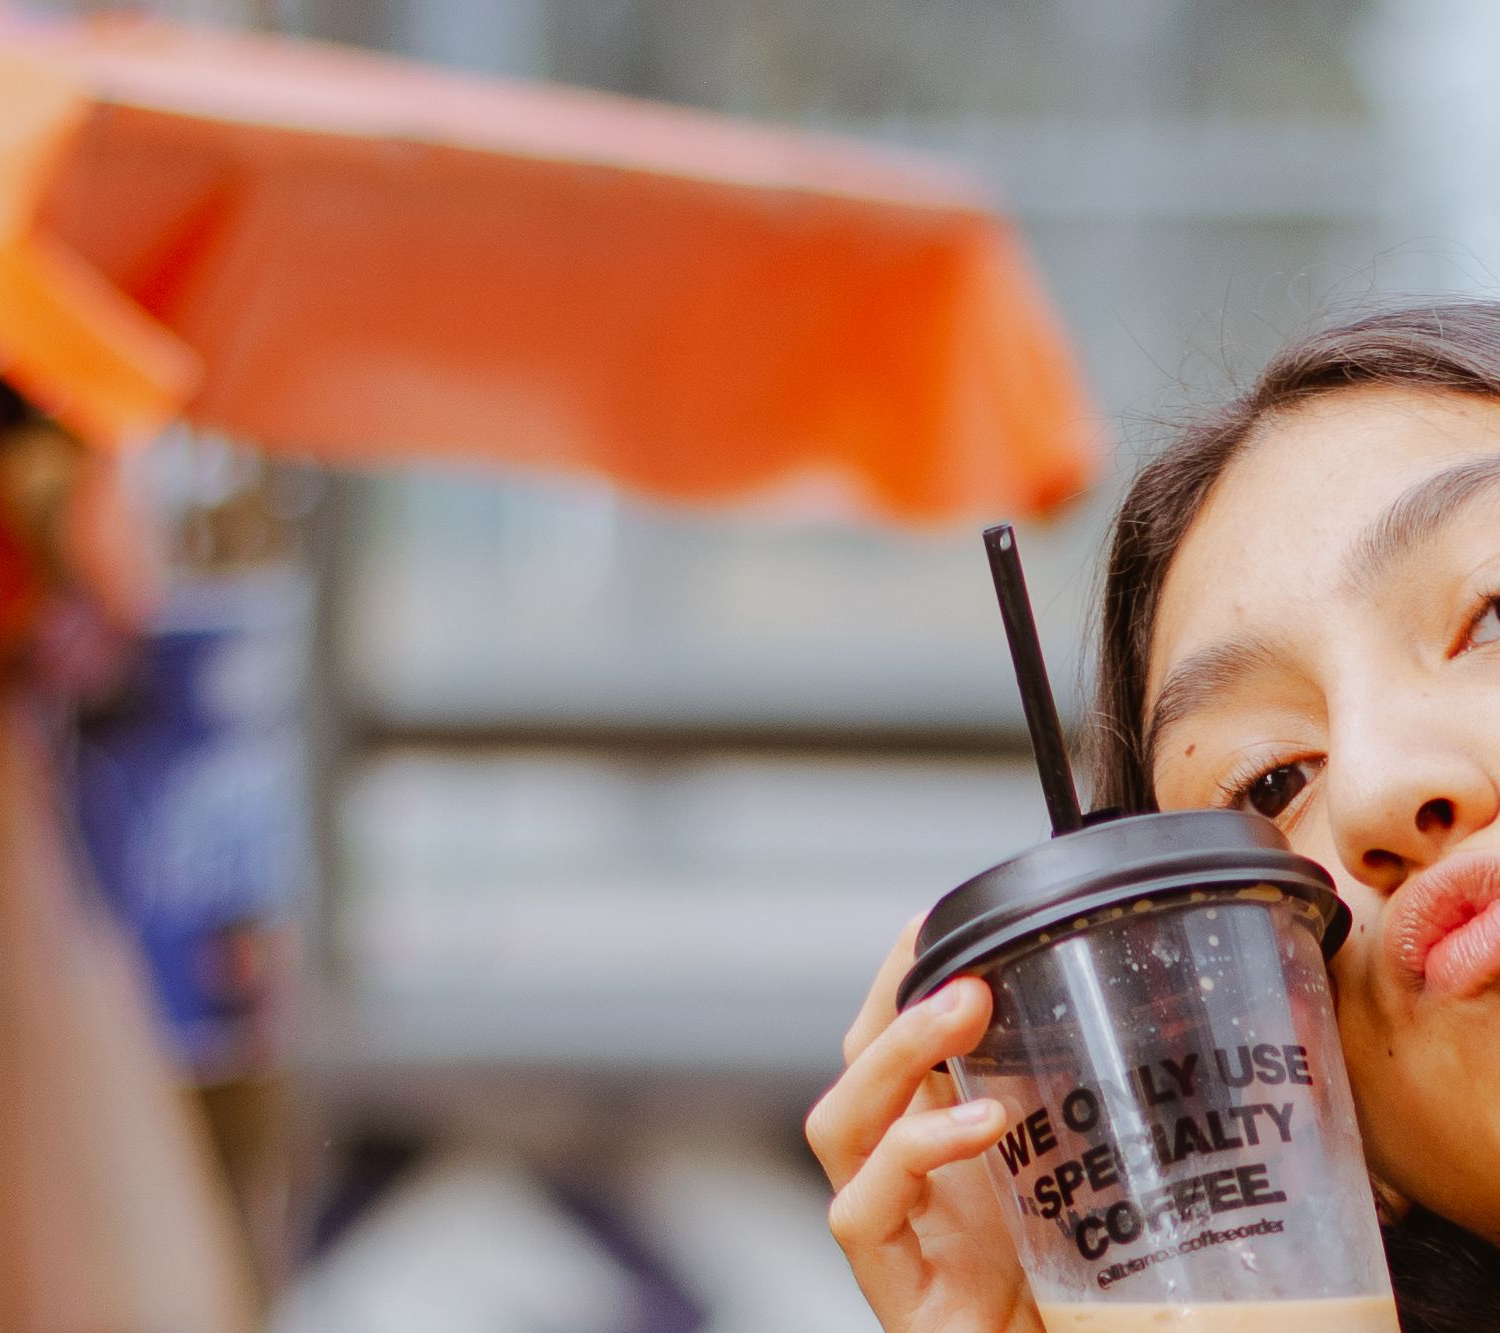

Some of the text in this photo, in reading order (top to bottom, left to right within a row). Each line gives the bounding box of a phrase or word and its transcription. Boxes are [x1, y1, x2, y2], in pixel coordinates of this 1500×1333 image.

[997, 1043, 1313, 1177] WE ONLY USE
[1033, 1103, 1293, 1220] SPECIALTY
